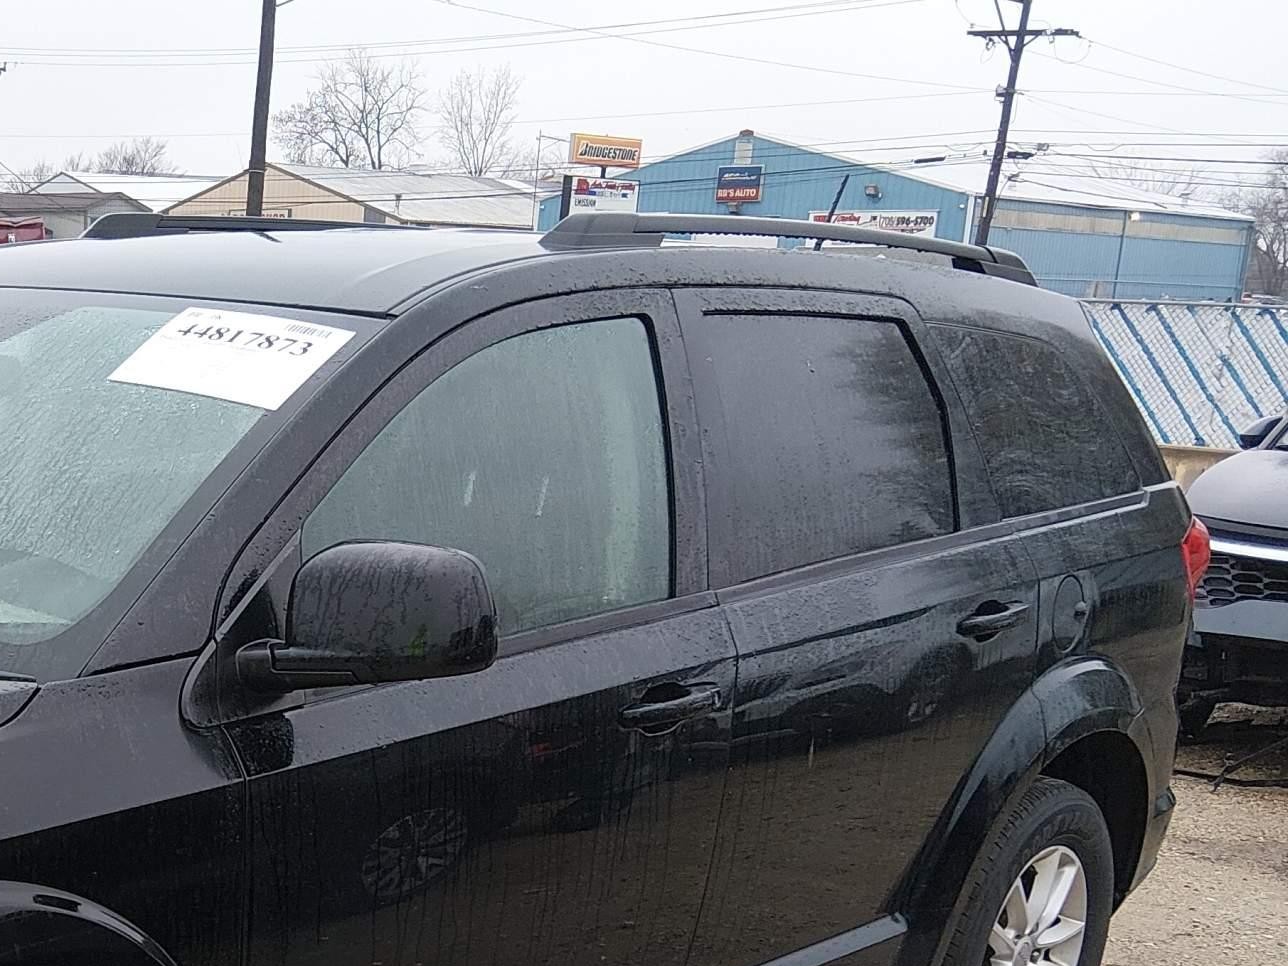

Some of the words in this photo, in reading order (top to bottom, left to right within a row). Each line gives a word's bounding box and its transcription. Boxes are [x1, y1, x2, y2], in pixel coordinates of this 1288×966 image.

[579, 142, 638, 160] BRIDGESTONE
[735, 188, 756, 197] AUTO
[178, 324, 313, 356] 44817873
